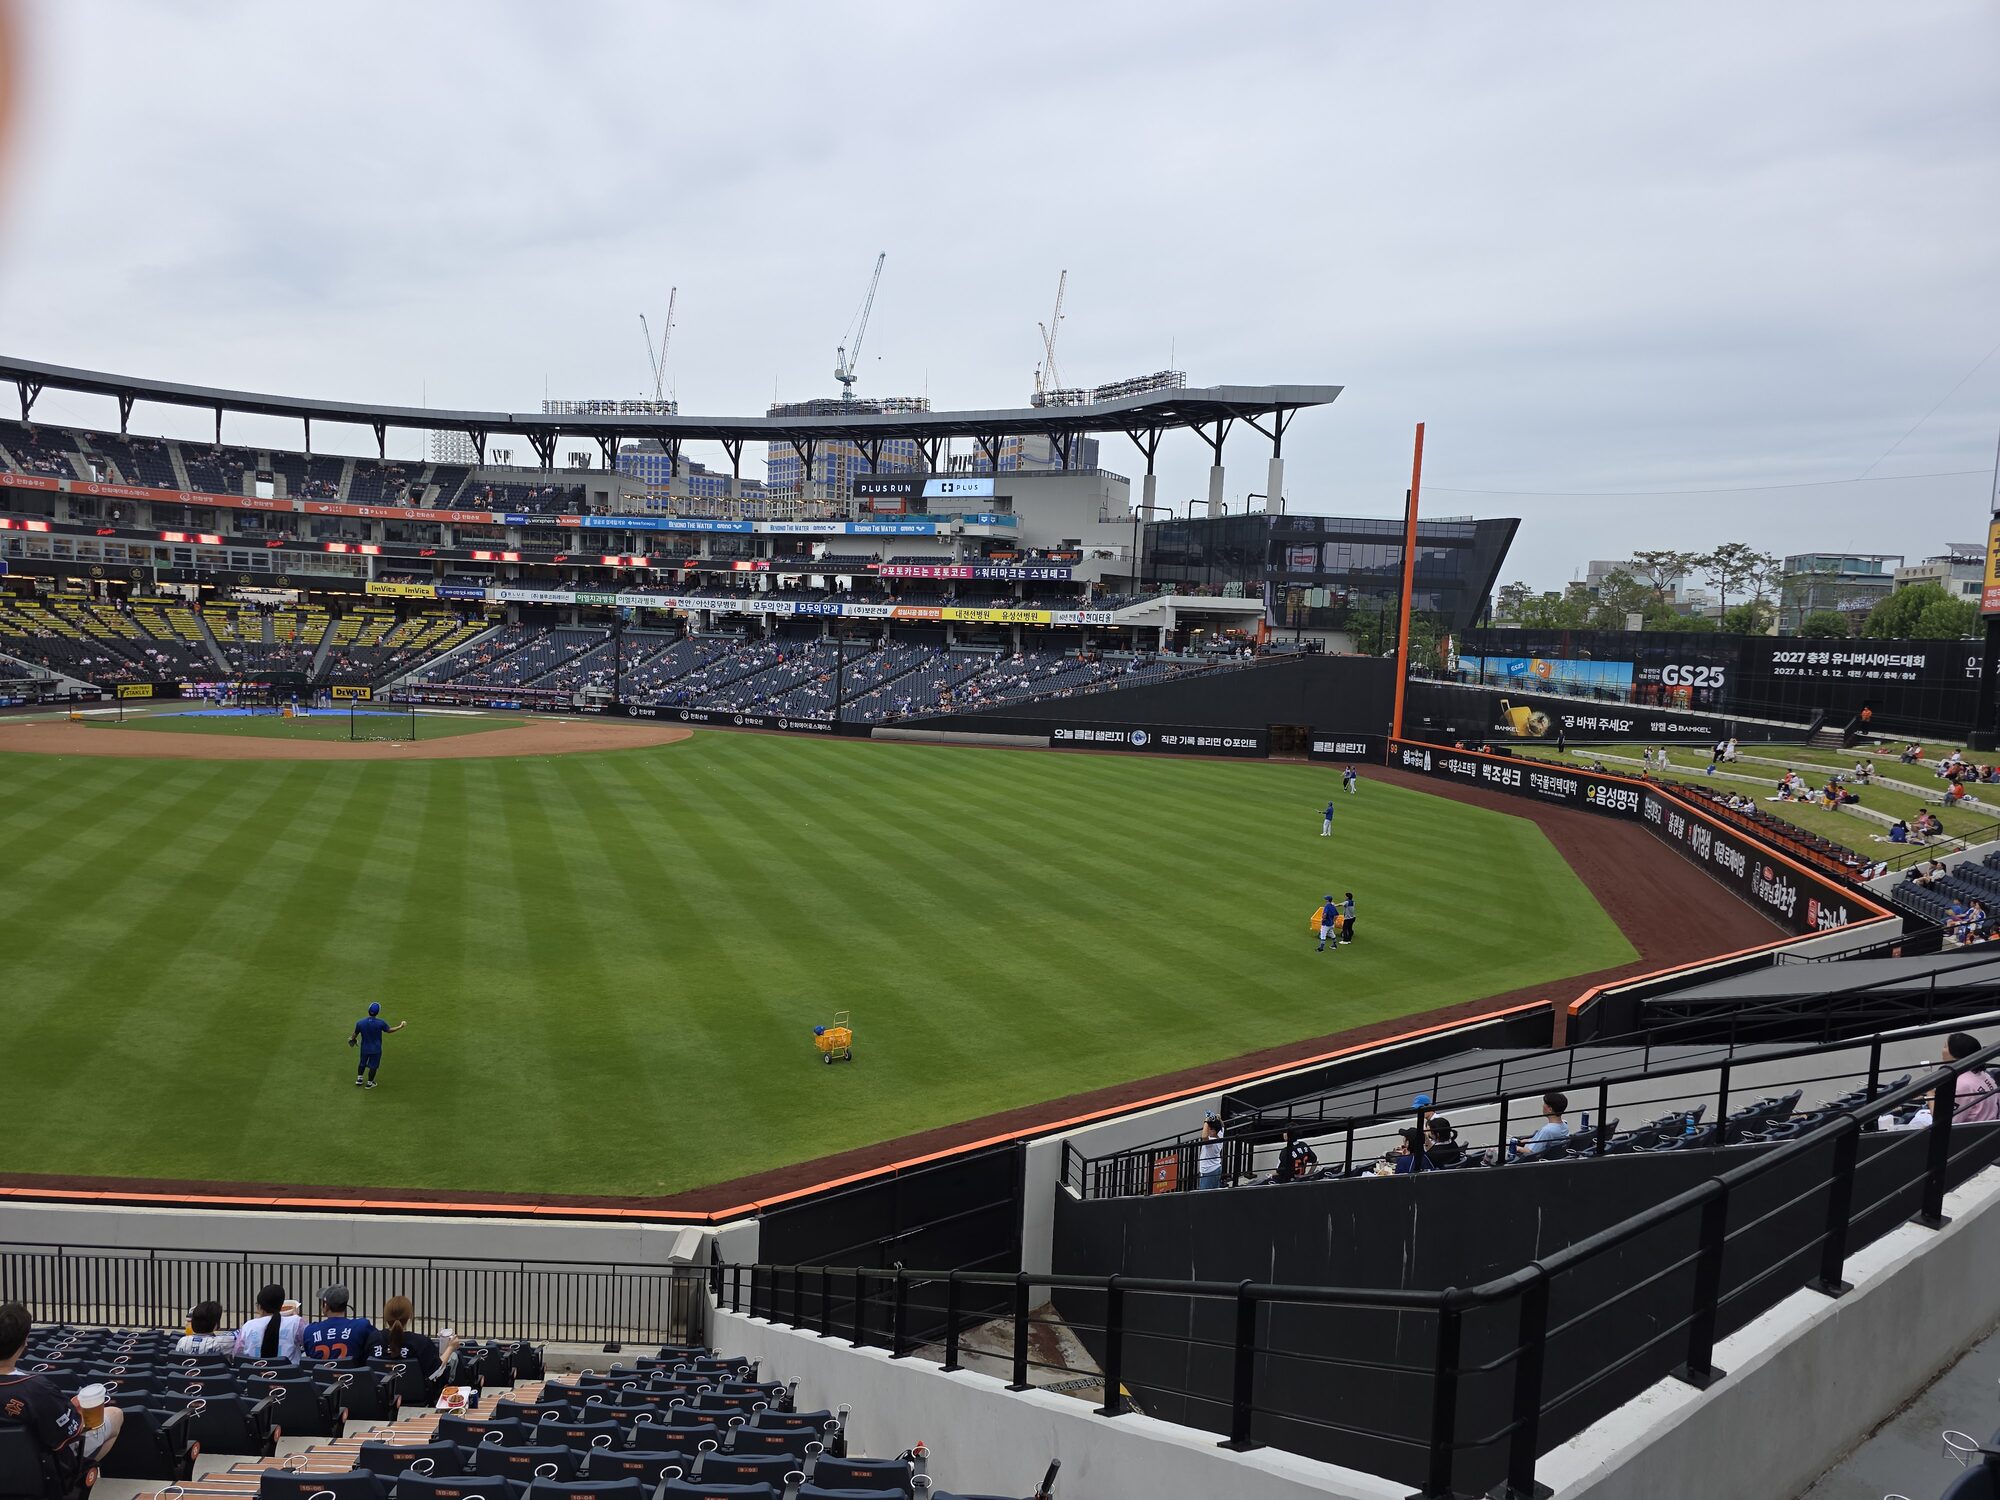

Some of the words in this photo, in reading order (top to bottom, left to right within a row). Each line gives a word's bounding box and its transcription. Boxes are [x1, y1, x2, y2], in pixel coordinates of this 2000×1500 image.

[861, 484, 911, 492] PLUSRUN
[887, 566, 929, 576] 포토카드는
[933, 567, 968, 577] 포토코드
[981, 568, 1026, 578] 워터마크는
[1031, 568, 1068, 579] 스냅태그
[753, 602, 775, 610] 모두의
[776, 602, 791, 611] 안과
[799, 604, 821, 612] 모두의
[822, 604, 839, 613] 안과
[955, 610, 990, 619] 대전선병원
[1002, 611, 1038, 621] 유성선병원
[1772, 652, 1805, 663] 2027
[1807, 652, 1830, 664] 충청
[1831, 653, 1926, 668] 유니버시아드대회
[1662, 664, 1725, 688] GS25
[1577, 716, 1597, 730] 바꿔
[1054, 729, 1073, 740] 오늘
[1074, 729, 1094, 740] 클립
[1095, 730, 1124, 742] 챌린지
[1161, 735, 1177, 745] 직관
[1179, 736, 1195, 746] 기록
[1197, 737, 1221, 747] 올리면
[1313, 741, 1335, 753] 클립
[1335, 742, 1366, 754] 챌린지
[1482, 763, 1521, 786] 백조씽크
[1530, 772, 1577, 796] 한국폴리텍대학
[1596, 785, 1639, 813] 음성명작
[1714, 840, 1746, 878] 대광로제비앙
